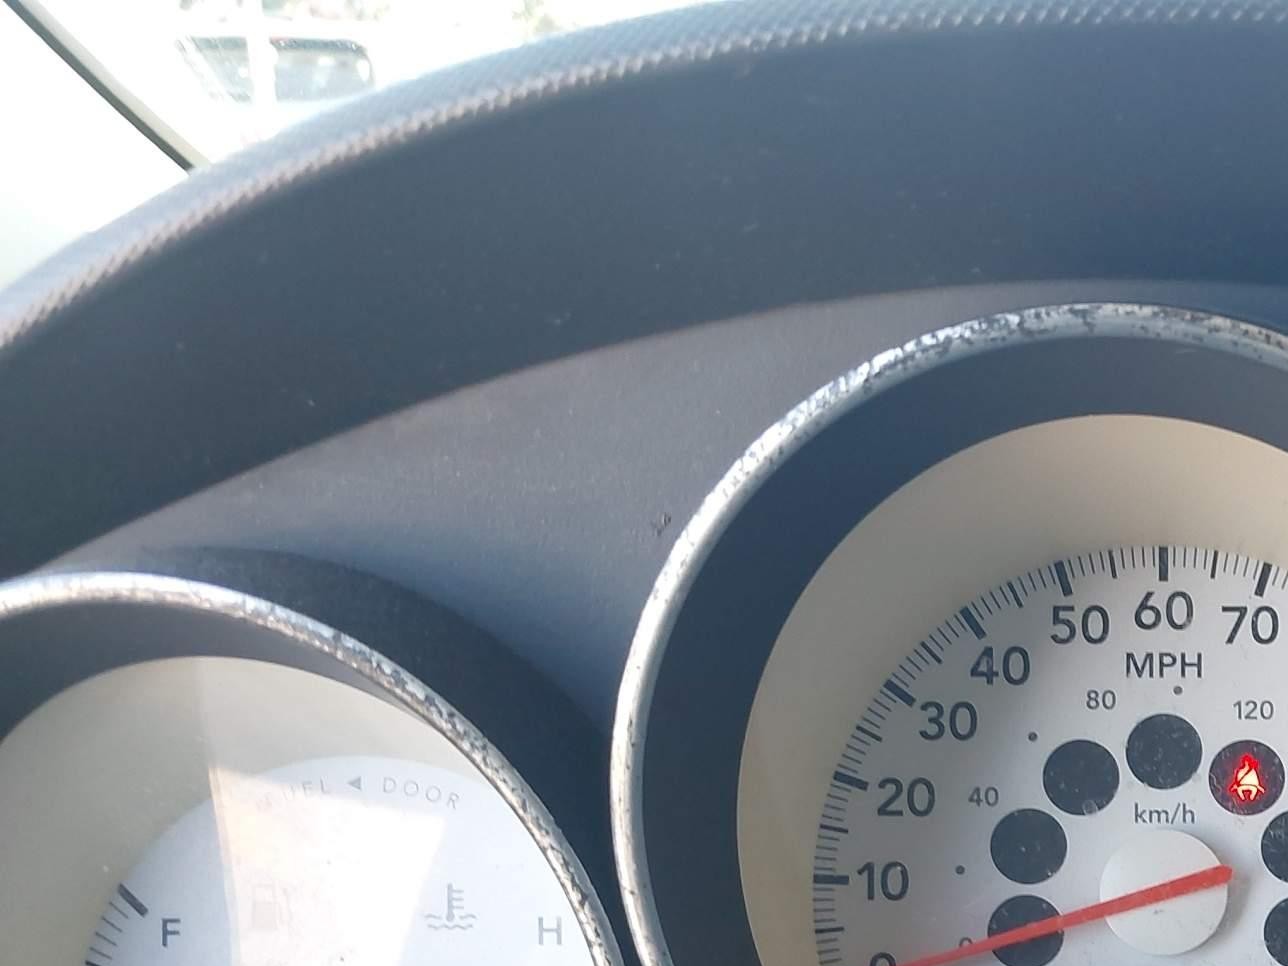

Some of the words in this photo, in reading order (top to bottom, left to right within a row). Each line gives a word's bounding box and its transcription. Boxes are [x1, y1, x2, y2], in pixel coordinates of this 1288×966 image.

[1051, 605, 1109, 644] 50
[1134, 591, 1193, 630] 60
[1222, 606, 1279, 644] 70
[970, 646, 1031, 685] 40
[1126, 653, 1202, 678] MPH
[1086, 690, 1116, 711] 80
[1233, 700, 1274, 720] 120
[919, 702, 977, 740] 30
[383, 777, 460, 810] DOOR
[877, 777, 935, 817] 20
[969, 786, 999, 807] 40
[1134, 803, 1195, 824] km/h
[857, 861, 909, 900] 10
[162, 918, 181, 946] F
[539, 917, 562, 945] H
